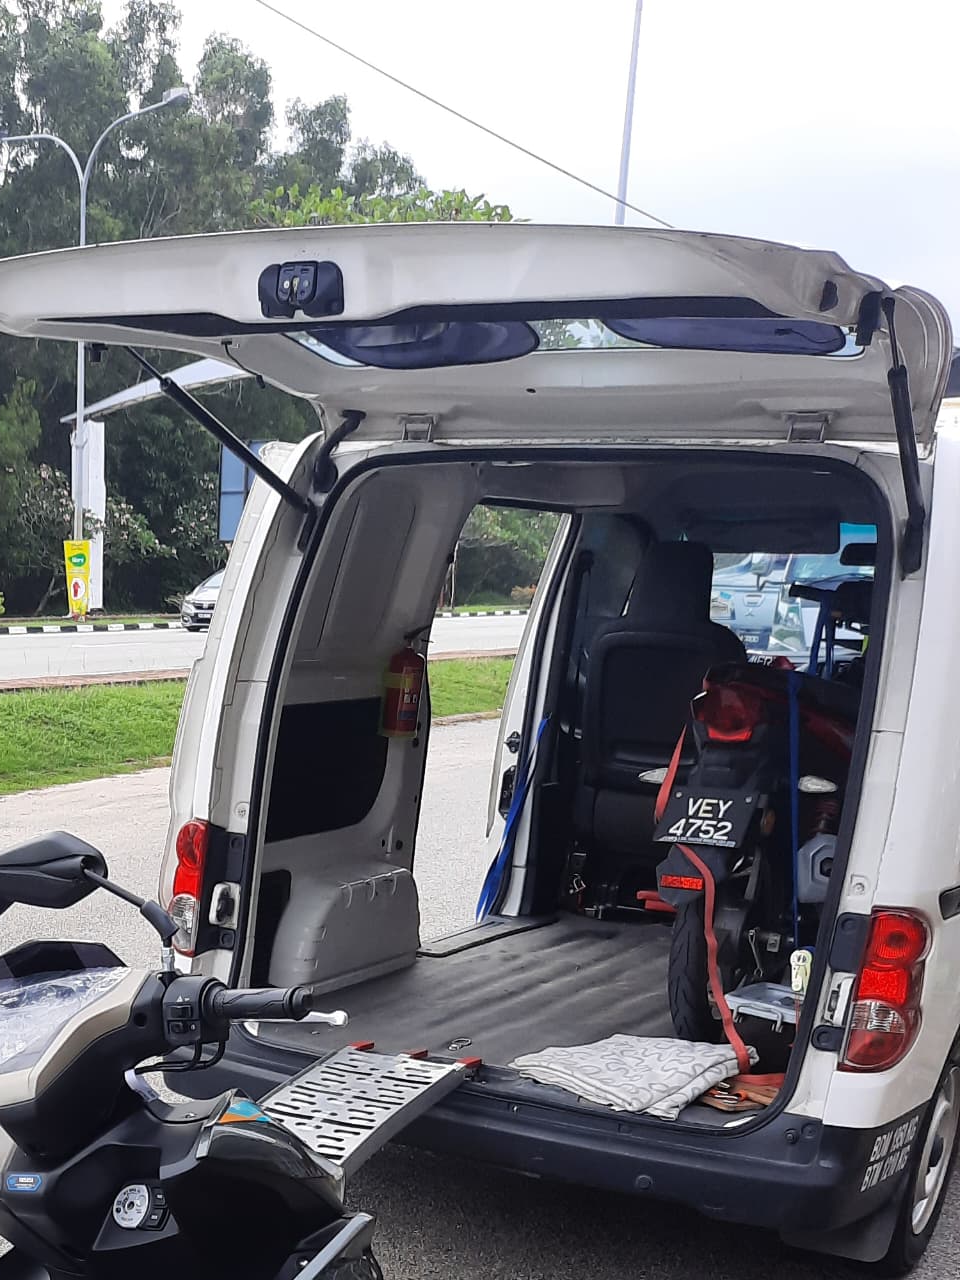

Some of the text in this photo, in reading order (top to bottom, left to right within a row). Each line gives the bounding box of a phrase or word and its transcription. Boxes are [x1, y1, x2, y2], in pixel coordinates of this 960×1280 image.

[688, 798, 733, 818] VEY
[669, 818, 732, 840] 4752
[860, 1160, 884, 1192] BTM
